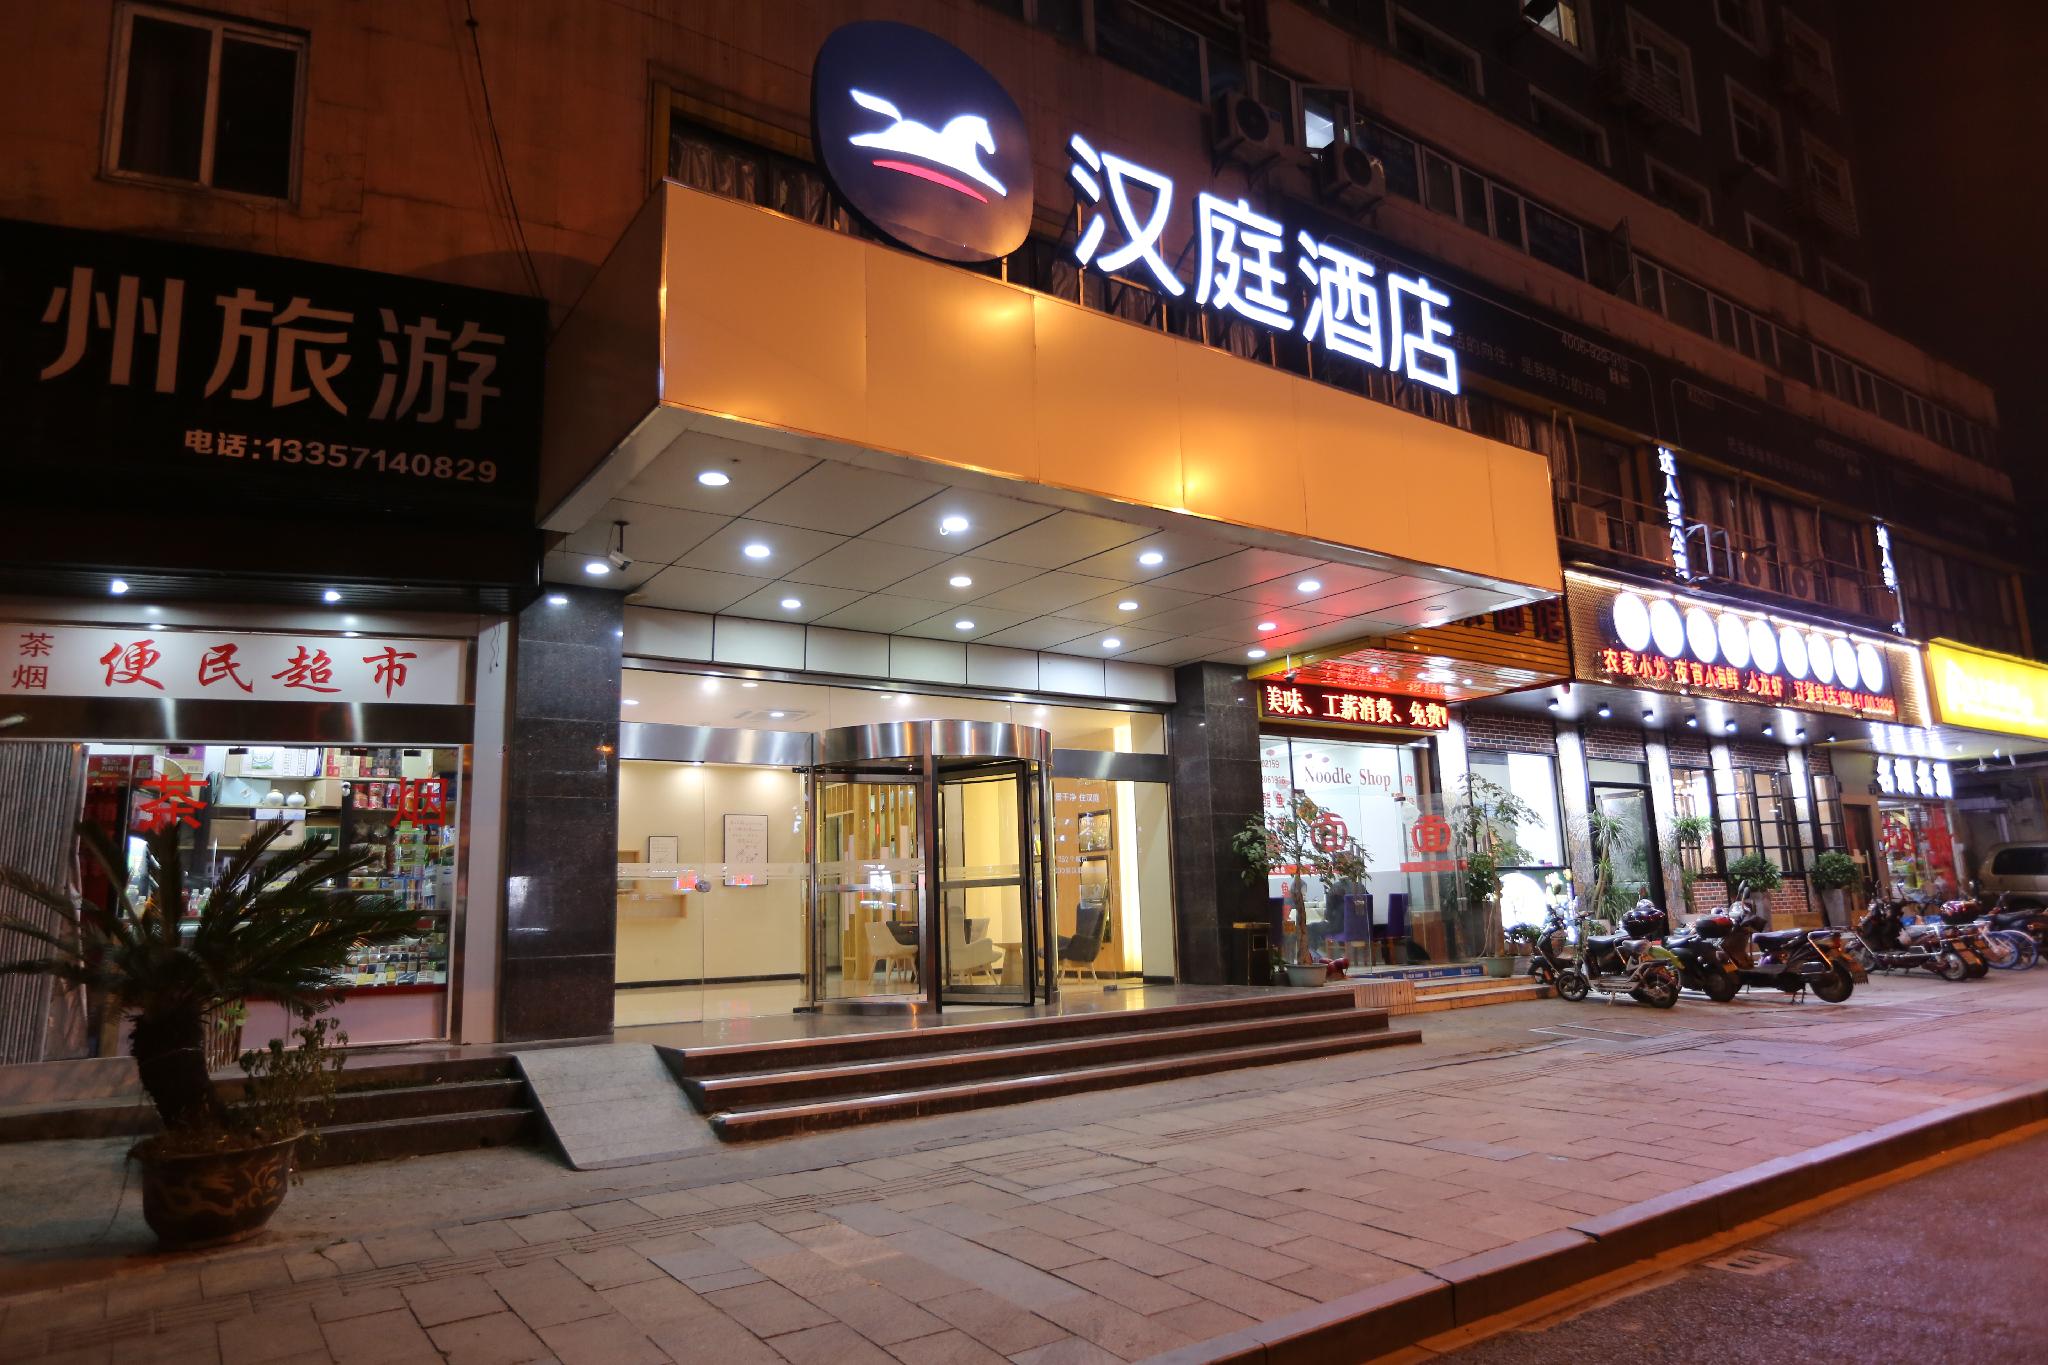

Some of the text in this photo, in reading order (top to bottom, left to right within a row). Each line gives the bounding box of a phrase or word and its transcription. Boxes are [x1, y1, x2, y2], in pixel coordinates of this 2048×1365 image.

[1067, 134, 1460, 396] 汉庭酒店
[40, 266, 507, 430] 州旅游
[100, 639, 417, 699] 便民超市
[1602, 647, 1669, 682] 农家小炒
[1674, 658, 1740, 692] 夜宵小海鲜
[1747, 669, 1784, 699] 小龙虾
[391, 776, 448, 828] 烟
[1304, 766, 1391, 792] Noodle Shop
